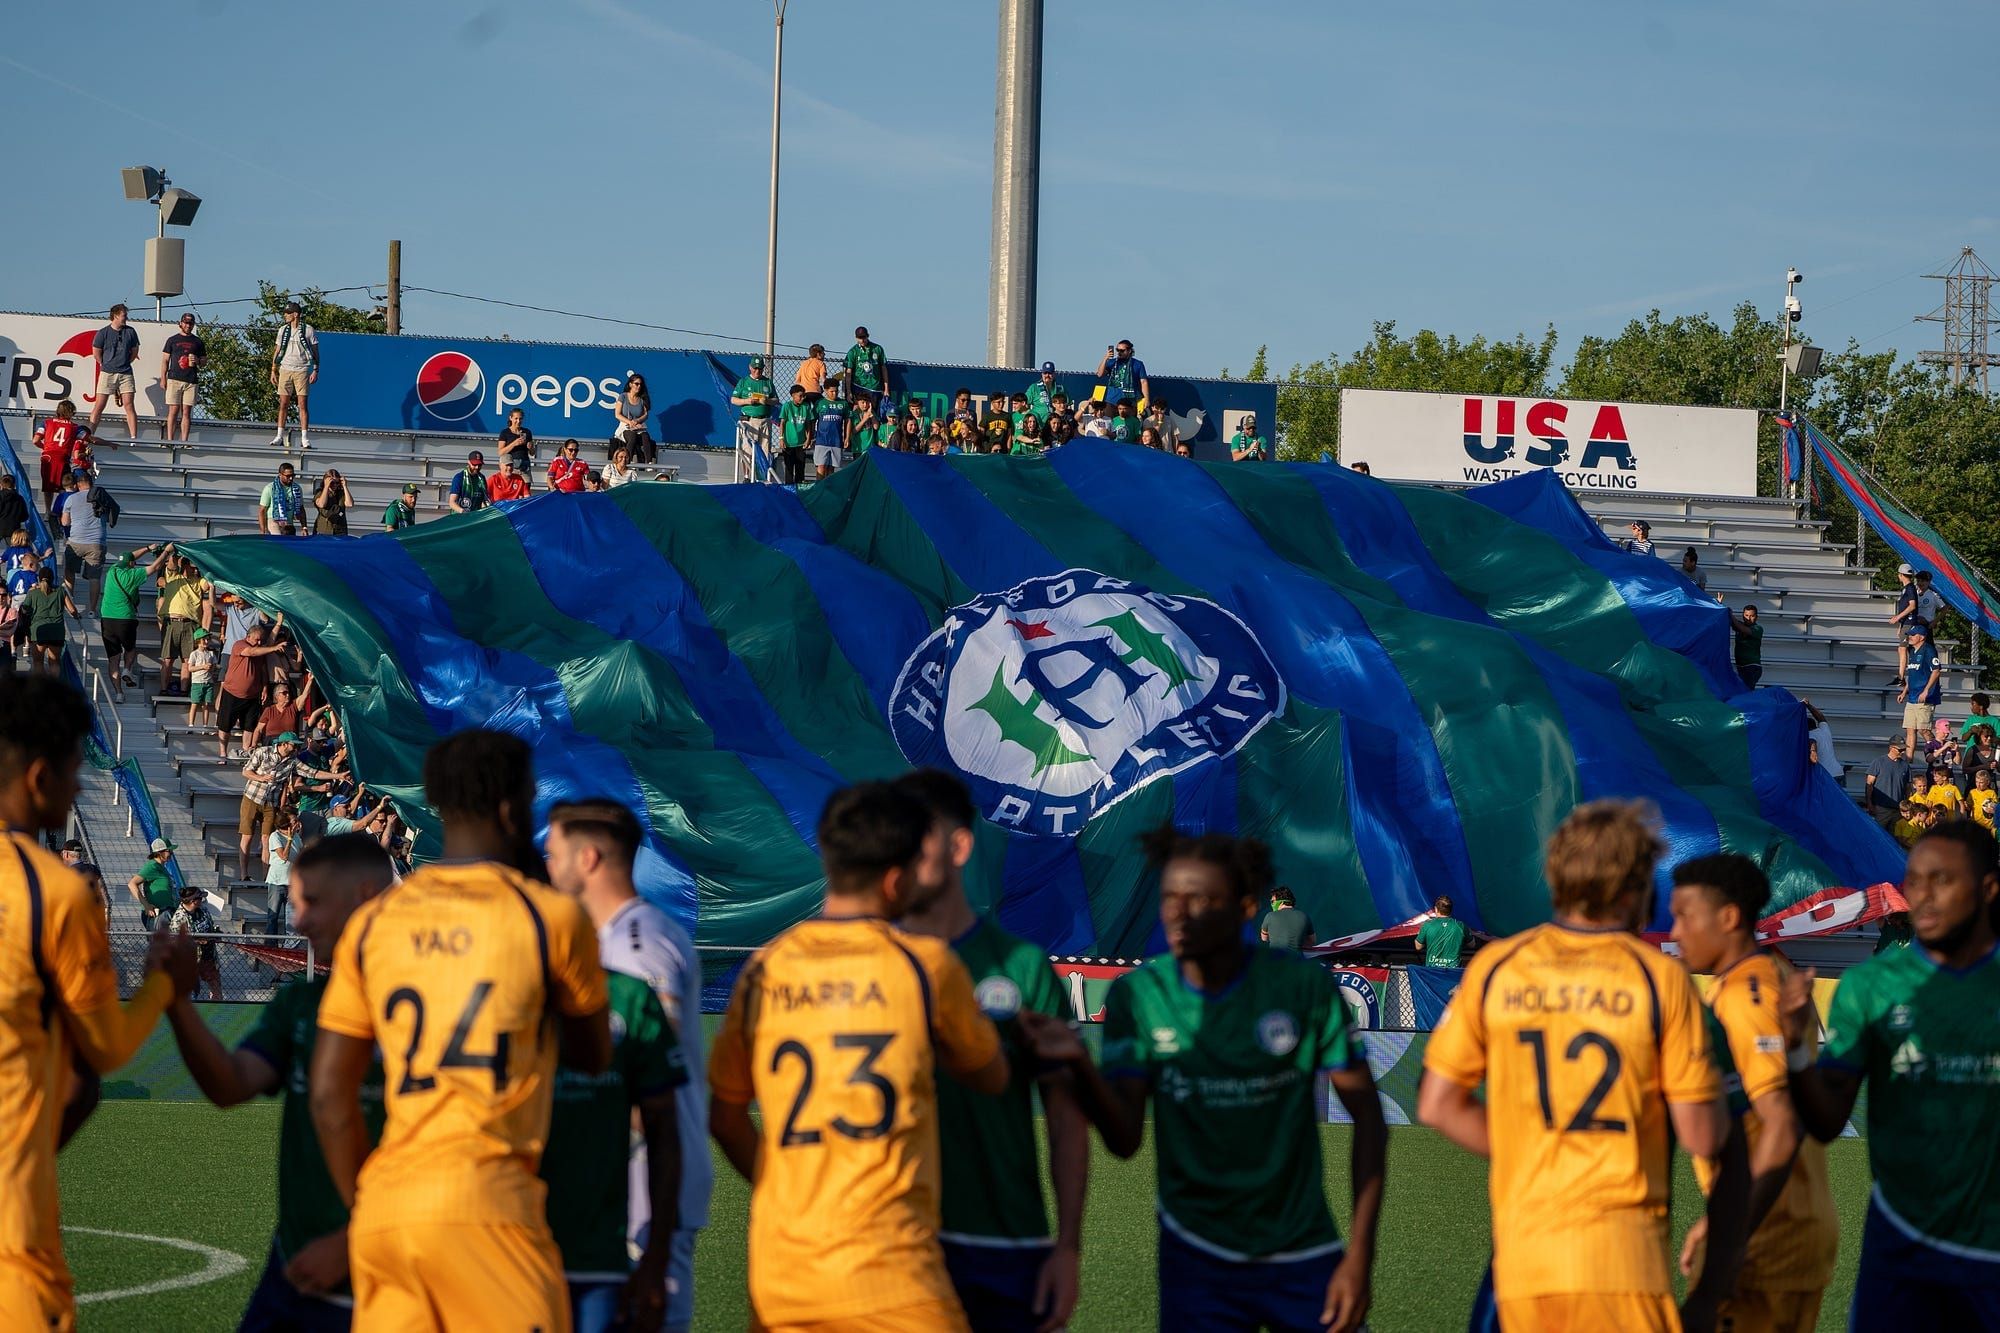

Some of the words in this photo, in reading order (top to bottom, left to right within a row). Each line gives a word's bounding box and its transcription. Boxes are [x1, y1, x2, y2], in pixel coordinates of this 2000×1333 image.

[0, 356, 74, 400] RS
[496, 370, 634, 418] peps
[53, 427, 66, 447] 4
[1463, 398, 1637, 471] USA
[1558, 472, 1637, 489] CYCLING
[15, 579, 25, 594] 4
[410, 926, 474, 956] YAO
[1504, 986, 1634, 1016] HOLSTAD
[385, 980, 510, 1095] 24
[770, 1032, 898, 1148] 23
[1518, 1030, 1627, 1133] 12
